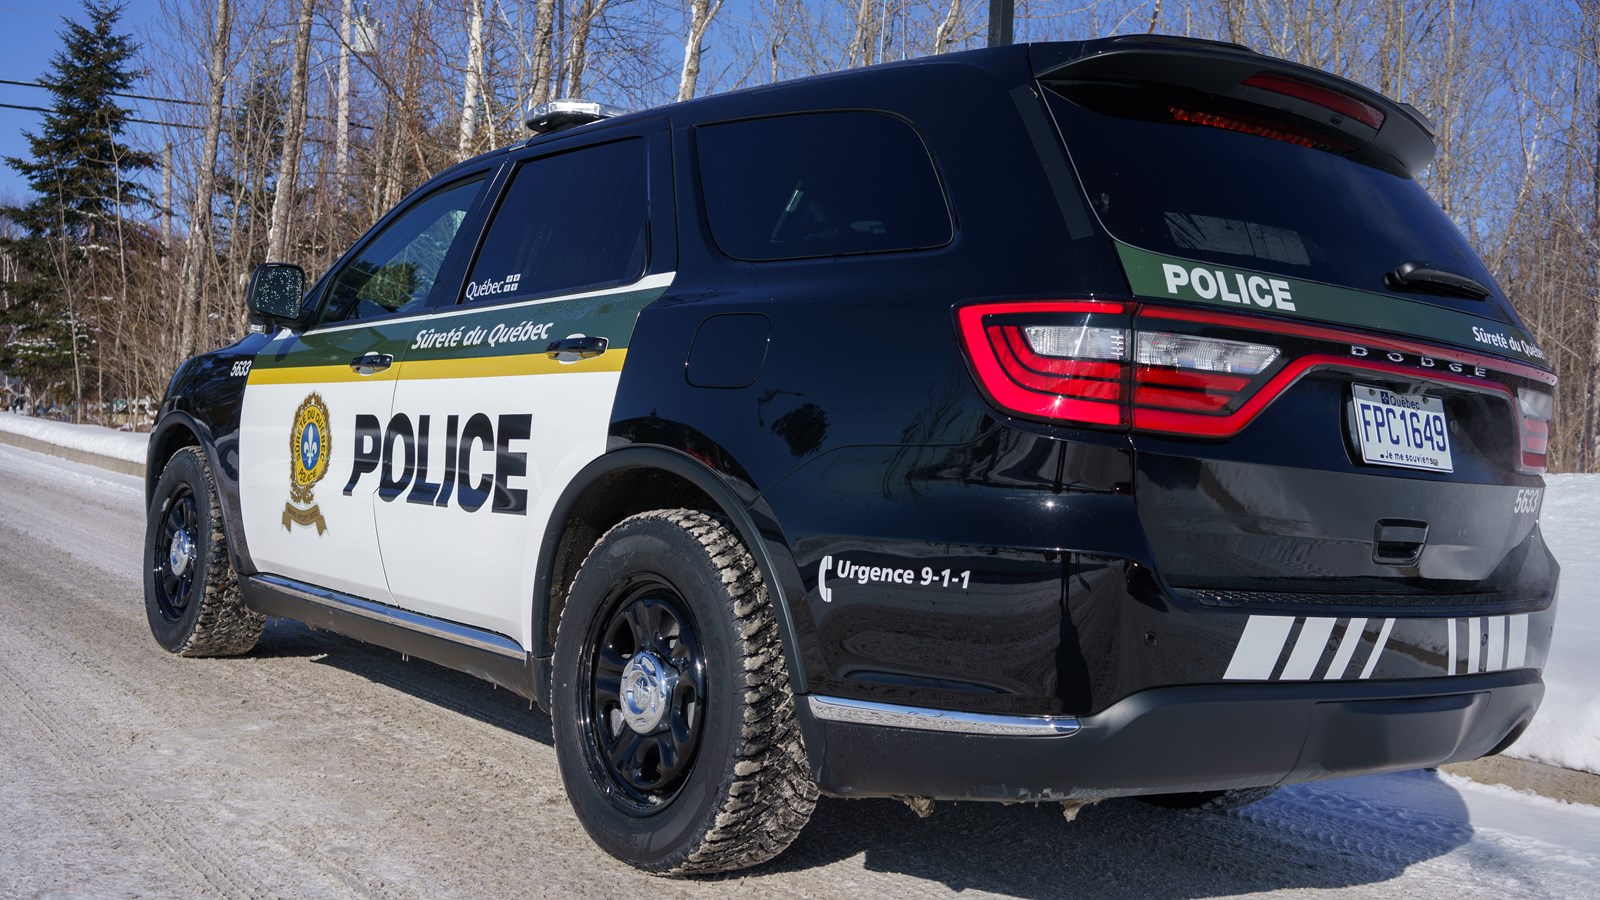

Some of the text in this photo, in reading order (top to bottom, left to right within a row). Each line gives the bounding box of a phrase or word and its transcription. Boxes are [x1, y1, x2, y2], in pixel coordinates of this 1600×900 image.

[465, 278, 505, 301] Québec
[1162, 263, 1297, 312] POLICE
[410, 320, 555, 350] Sûreté du Québec
[1472, 326, 1508, 349] Sûreté
[1508, 336, 1523, 353] du
[230, 360, 253, 377] 5633
[1351, 345, 1487, 378] DODGE
[1388, 395, 1421, 411] Québec
[1360, 403, 1447, 453] FPC1649
[342, 412, 534, 517] POLICE
[1385, 450, 1434, 465] Je me souviens
[1514, 489, 1539, 514] 5633
[837, 559, 971, 589] Urgence 9-1-1
